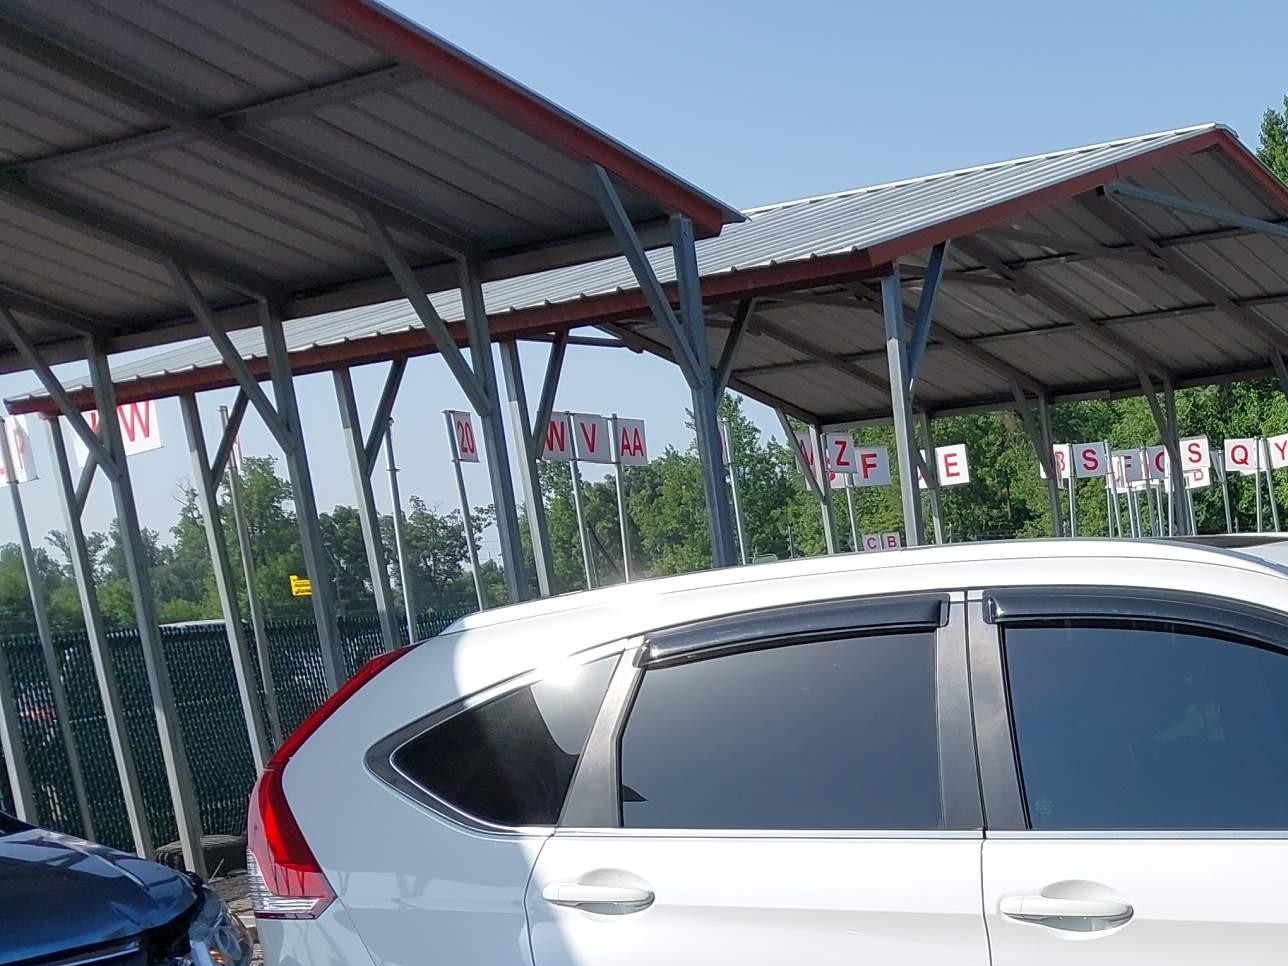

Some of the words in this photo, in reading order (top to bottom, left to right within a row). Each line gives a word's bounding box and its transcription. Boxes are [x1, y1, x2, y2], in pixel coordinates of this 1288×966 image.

[116, 401, 150, 442] W
[457, 420, 476, 454] 20
[580, 422, 597, 453] V
[621, 427, 645, 457] AA
[835, 440, 850, 467] Z
[1082, 449, 1099, 471] S
[1188, 443, 1202, 463] S
[1231, 445, 1249, 465] Q
[1275, 440, 1288, 461] Y
[861, 453, 878, 480] F
[944, 453, 961, 478] E
[867, 538, 878, 550] C
[888, 536, 898, 548] B
